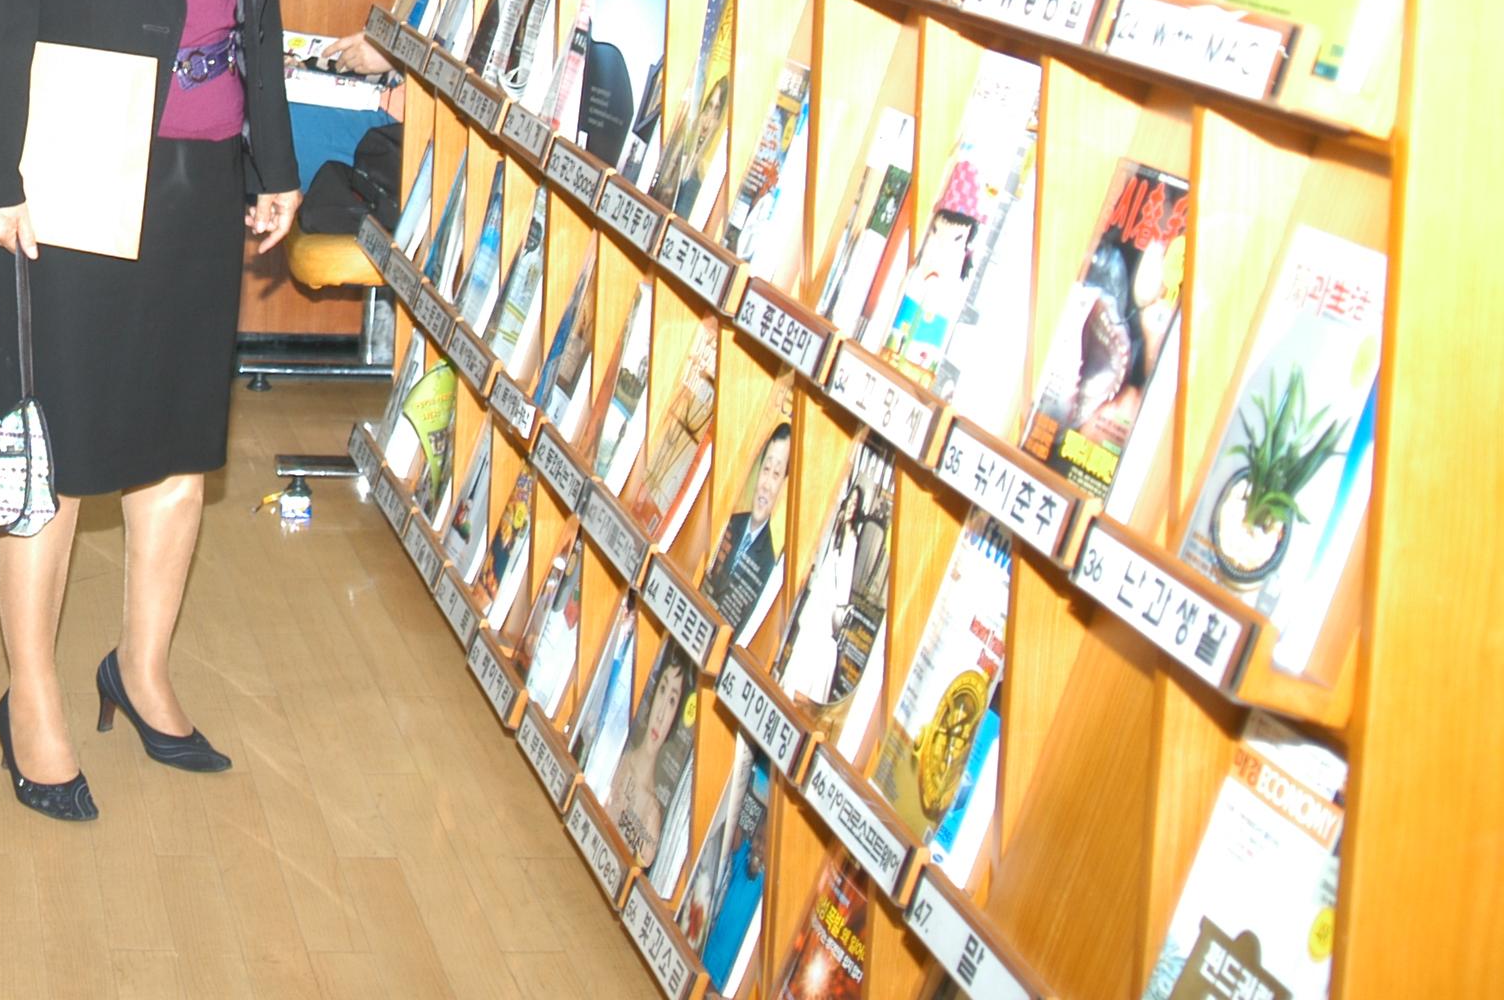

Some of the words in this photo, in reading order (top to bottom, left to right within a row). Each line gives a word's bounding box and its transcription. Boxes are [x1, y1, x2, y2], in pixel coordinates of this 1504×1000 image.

[675, 239, 723, 296] 국가고시
[759, 303, 813, 366] 좋은엄마
[973, 451, 1058, 536] 낚시춘추
[1115, 559, 1228, 668] 난과생활
[740, 681, 796, 761] 마이웨딩
[955, 931, 986, 987] 말
